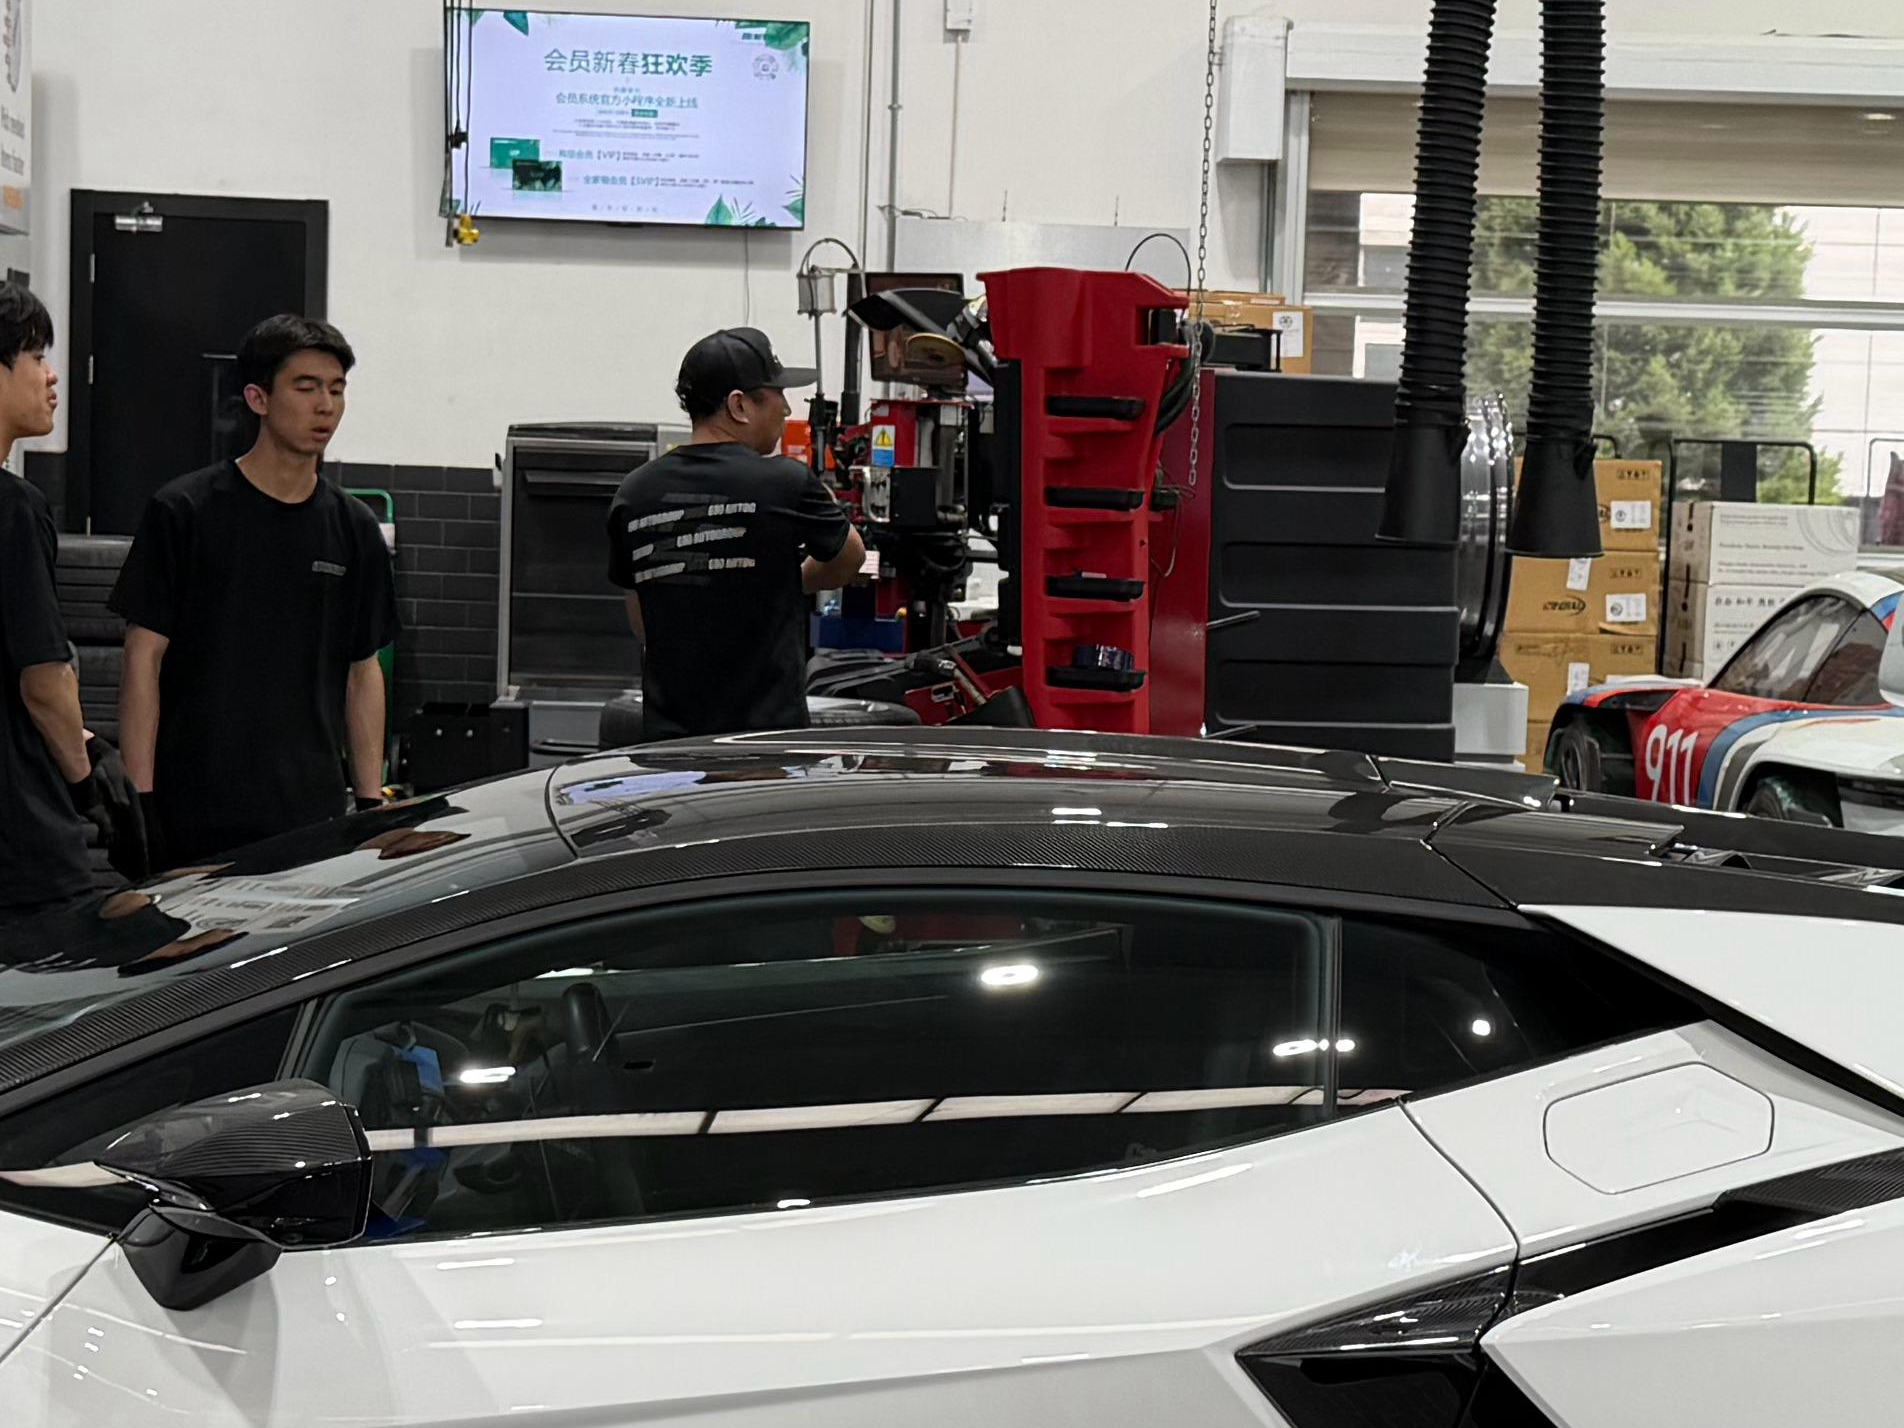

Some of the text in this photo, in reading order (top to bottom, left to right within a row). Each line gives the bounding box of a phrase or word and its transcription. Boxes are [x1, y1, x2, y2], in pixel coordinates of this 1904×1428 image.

[544, 48, 712, 77] 会员新春狂欢季
[1645, 723, 1699, 807] 911
